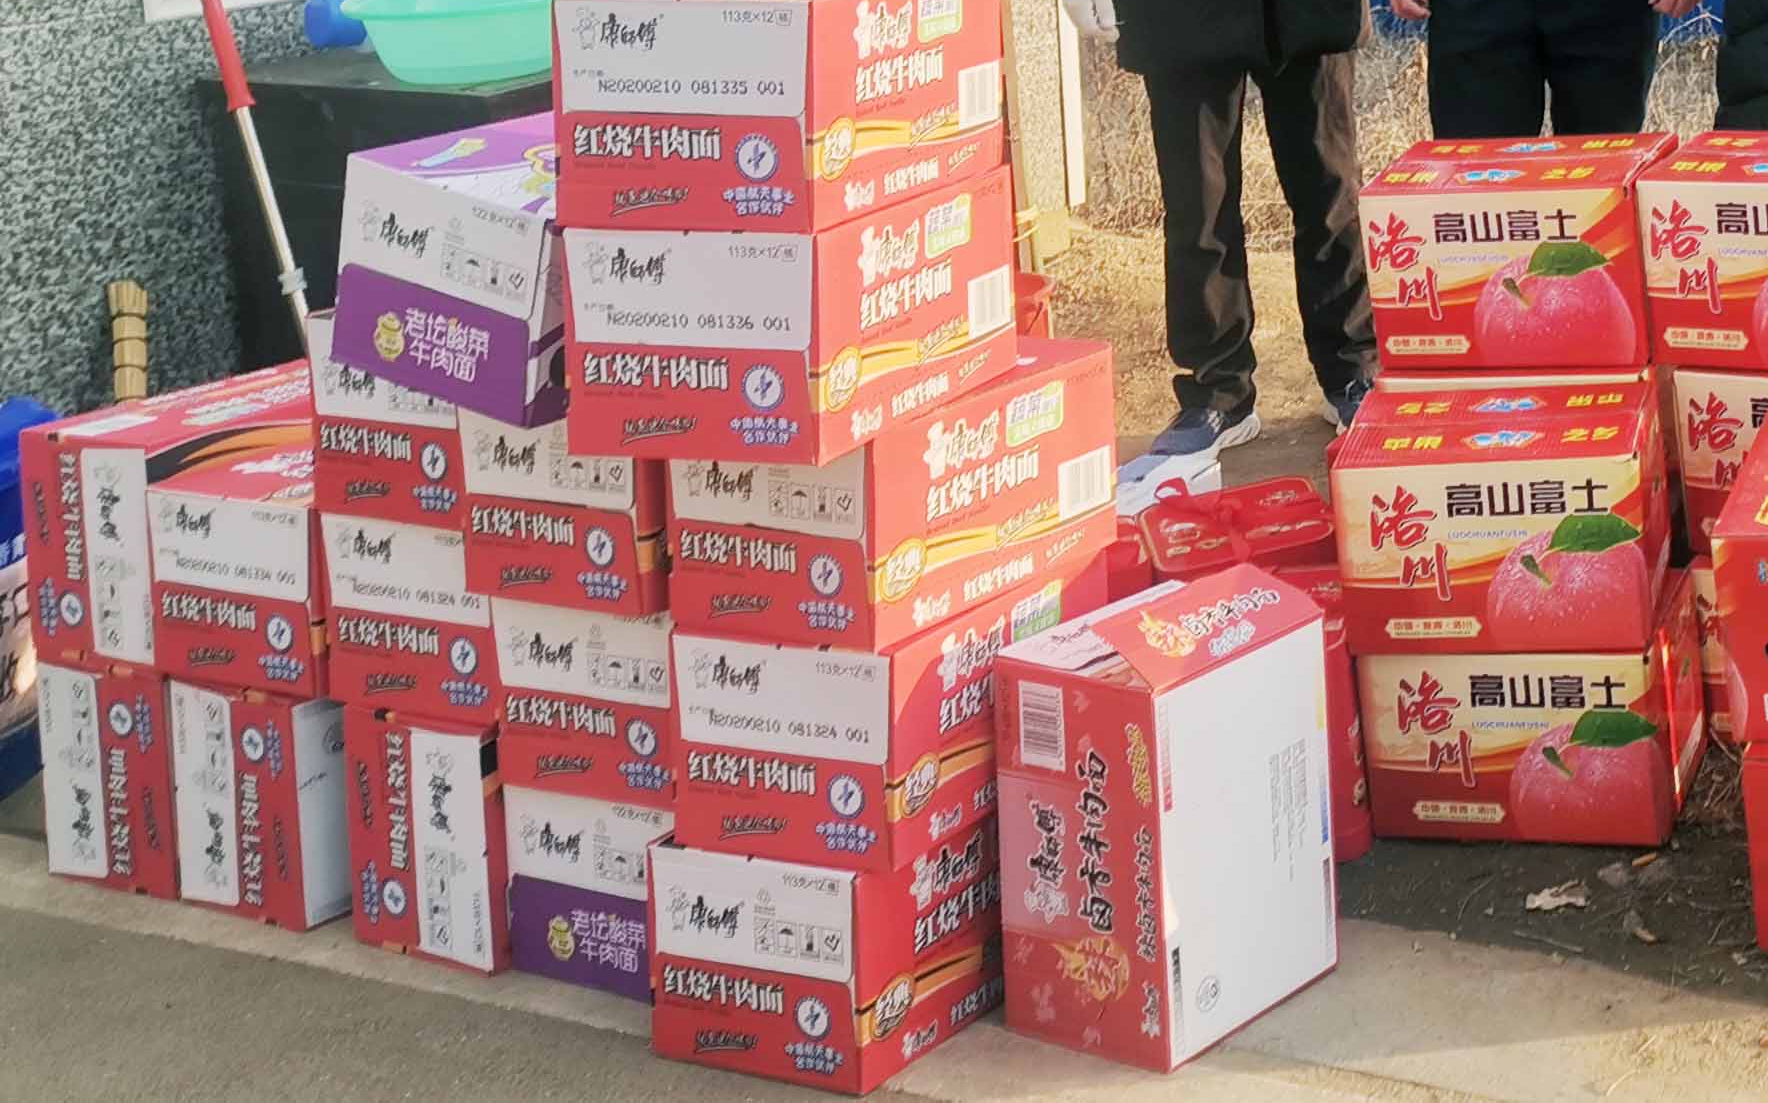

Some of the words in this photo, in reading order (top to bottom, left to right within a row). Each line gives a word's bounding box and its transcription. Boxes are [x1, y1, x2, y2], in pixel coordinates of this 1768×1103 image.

[600, 12, 658, 50] 康师傅
[598, 78, 682, 94] N20200210
[691, 80, 748, 95] 081335
[757, 80, 785, 95] 001
[855, 46, 945, 104] 红烧牛肉面
[574, 124, 721, 160] 红烧牛肉面
[1434, 208, 1580, 243] 高山富士
[609, 247, 666, 284] 康师傅
[1367, 211, 1443, 320] 洛川
[1650, 199, 1722, 314] 洛川
[860, 257, 953, 331] 红烧牛肉面
[404, 306, 491, 360] 老坛酸菜
[607, 311, 689, 329] N20200210
[763, 316, 791, 331] 001
[408, 340, 477, 383] 牛肉面
[584, 352, 729, 391] 红烧牛肉面
[320, 421, 413, 461] 红烧牛肉面
[926, 444, 1040, 524] 红烧牛肉面
[1445, 478, 1609, 518] 高山富士
[471, 505, 576, 547] 红烧牛肉面
[1369, 485, 1454, 602] 洛川
[680, 529, 797, 574] 红烧牛肉面
[162, 590, 256, 631] 红烧牛肉面
[338, 615, 440, 656] 红烧牛肉面
[1468, 673, 1627, 710] 高山富士
[505, 695, 617, 738] 红烧牛肉面
[1398, 670, 1478, 788] 洛川
[687, 749, 817, 796] 红烧牛肉面
[386, 730, 410, 873] 红烧牛肉面
[1028, 800, 1067, 888] 康师傅
[1076, 749, 1115, 933] 卤香牛肉面
[570, 909, 647, 950] 老坛酸菜
[579, 937, 640, 973] 牛肉面
[664, 964, 784, 1014] 红烧牛肉面
